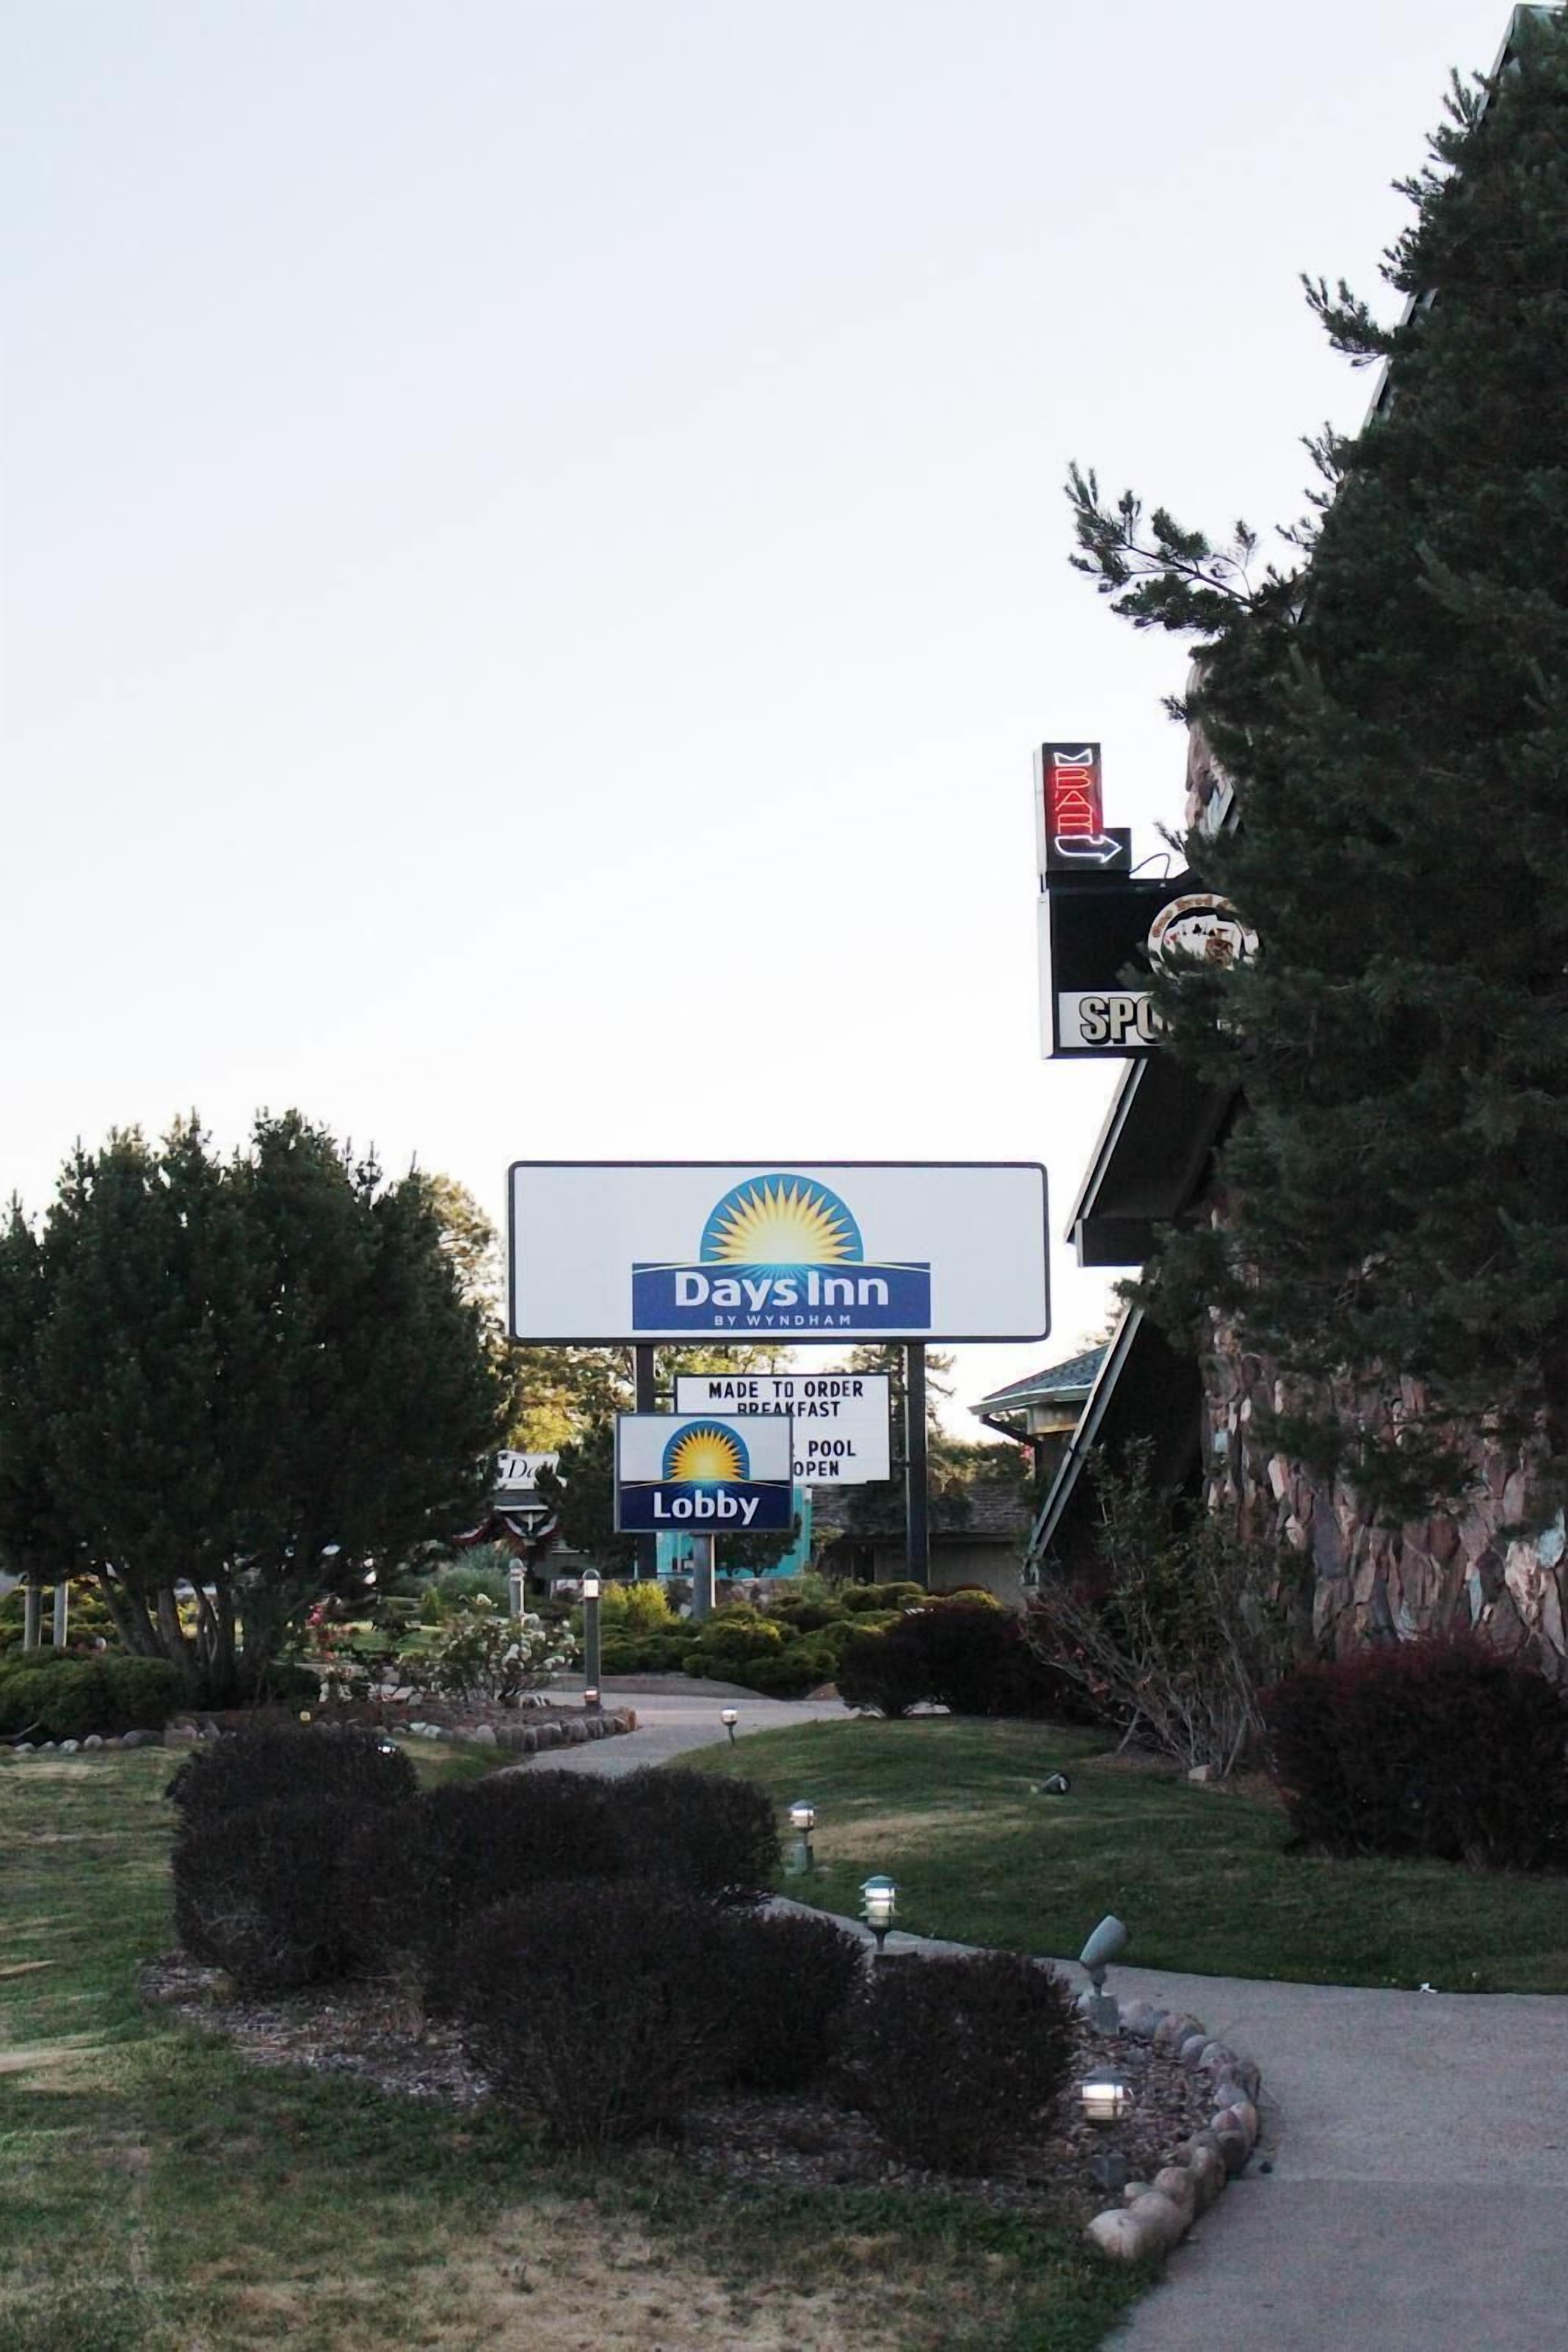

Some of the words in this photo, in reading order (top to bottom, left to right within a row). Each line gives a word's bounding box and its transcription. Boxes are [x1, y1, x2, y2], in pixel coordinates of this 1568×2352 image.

[1055, 768, 1093, 834] BAR
[1079, 996, 1166, 1044] SPO
[675, 1271, 798, 1312] Days
[808, 1270, 889, 1306] Inn
[715, 1315, 736, 1326] BY
[746, 1315, 851, 1326] WYNDHAM
[708, 1381, 759, 1399] MADE
[772, 1381, 794, 1398] TO
[804, 1381, 864, 1397] ORDER
[737, 1401, 841, 1417] BREAKFAST
[808, 1440, 856, 1457] POOL
[794, 1461, 840, 1476] OPEN
[653, 1489, 760, 1525] Lobby
